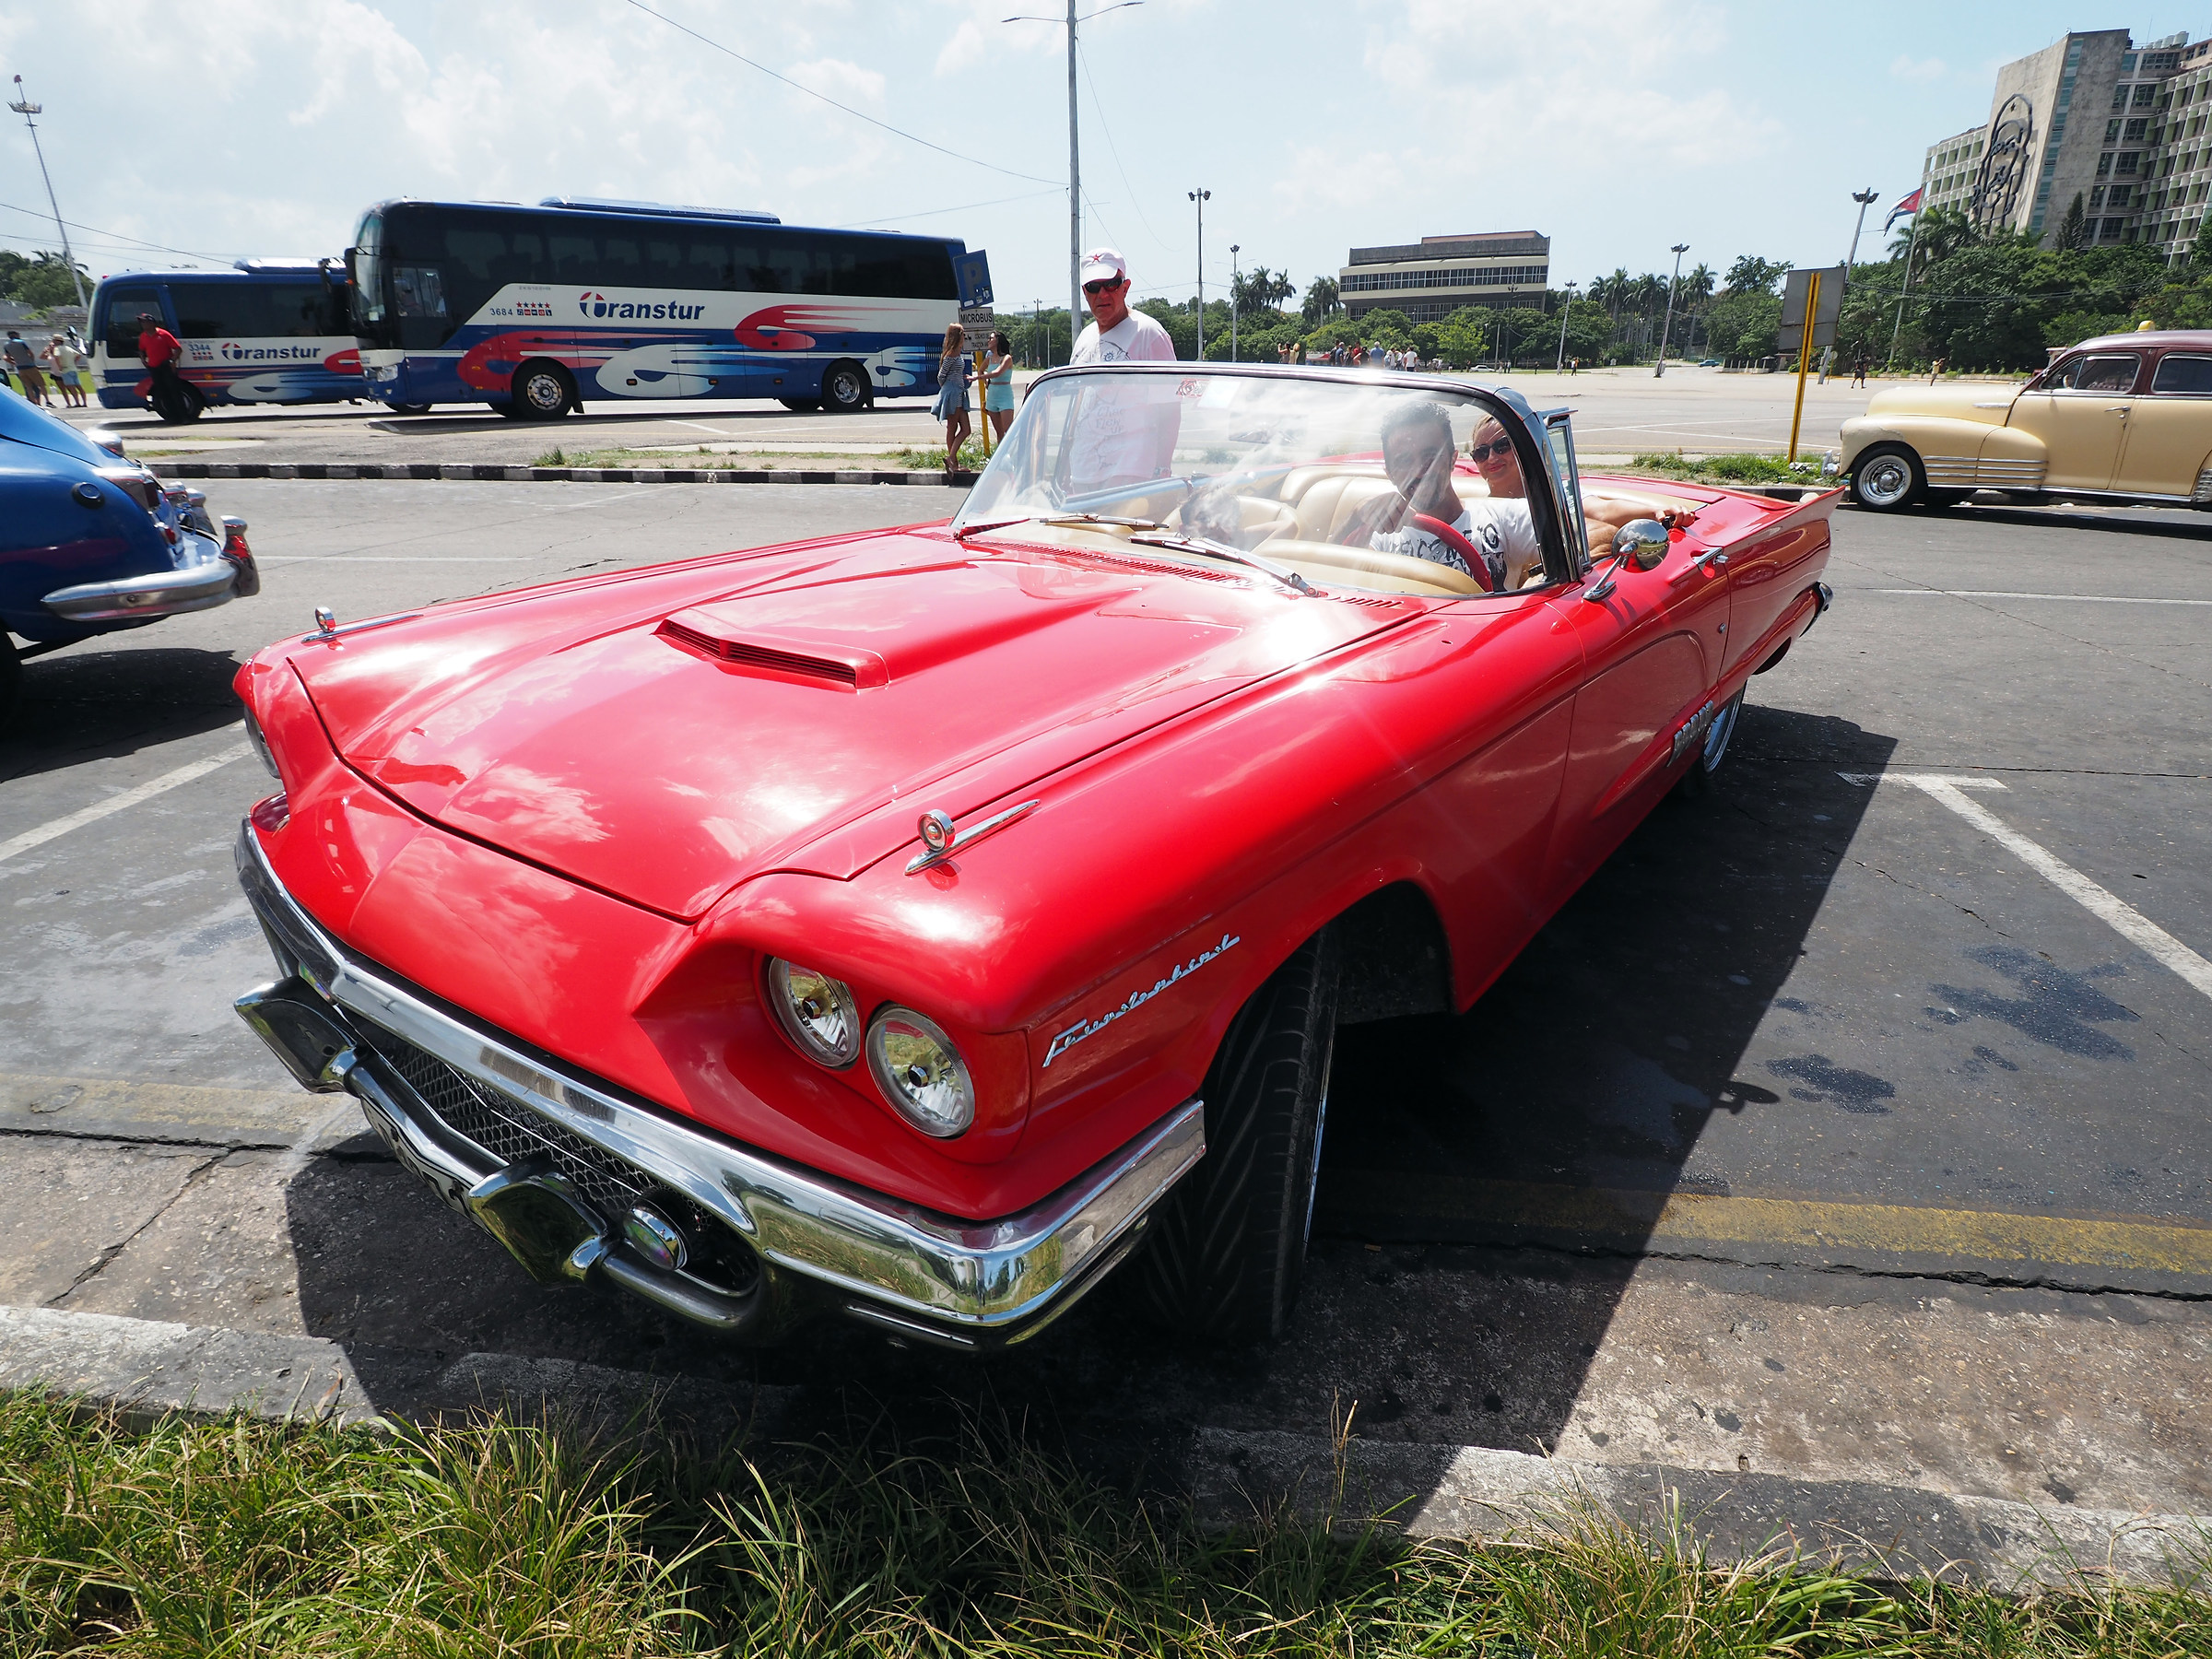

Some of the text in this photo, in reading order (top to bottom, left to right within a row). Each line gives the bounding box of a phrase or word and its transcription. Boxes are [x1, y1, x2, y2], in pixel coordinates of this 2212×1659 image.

[962, 262, 983, 300] P
[489, 308, 513, 316] 3684
[960, 312, 993, 324] MICROBUS
[188, 344, 211, 352] 3344
